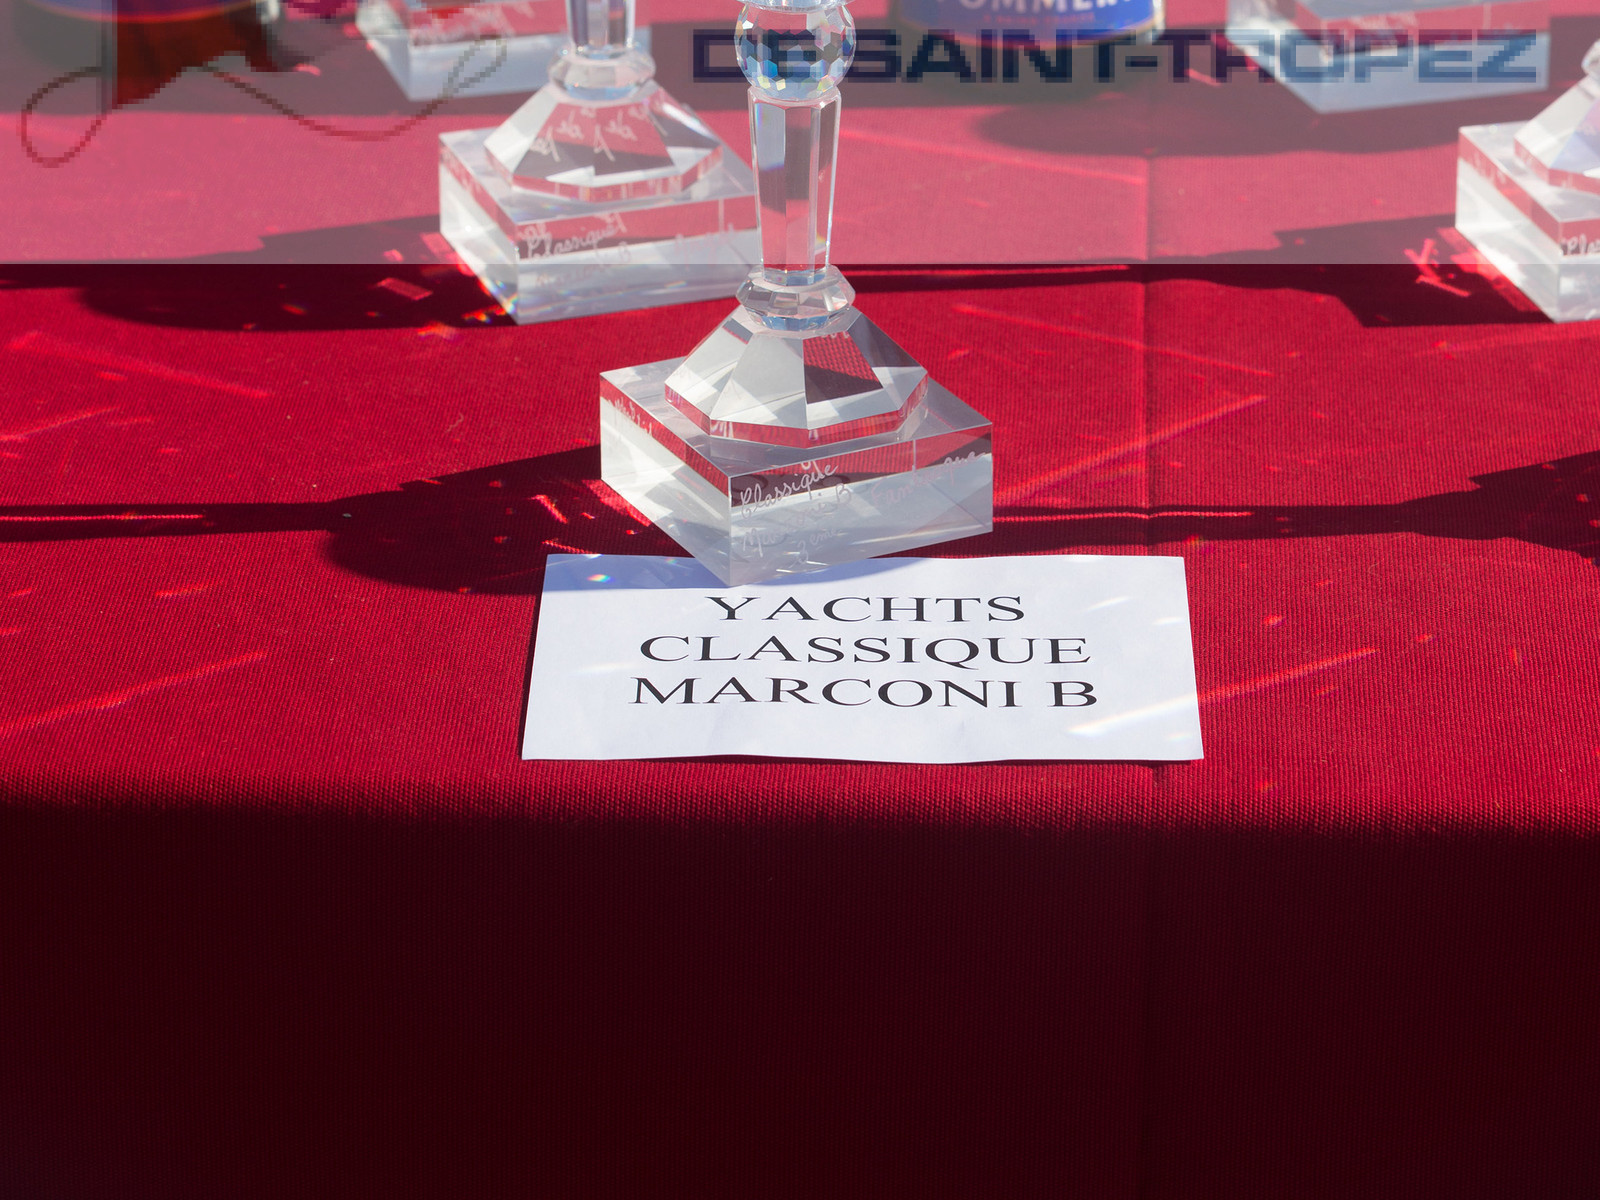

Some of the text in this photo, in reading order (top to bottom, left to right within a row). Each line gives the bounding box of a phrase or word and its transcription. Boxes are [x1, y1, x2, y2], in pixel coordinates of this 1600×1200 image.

[740, 461, 839, 519] Classique
[704, 596, 1025, 622] YACHTS
[640, 635, 1091, 670] CLASSIQUE
[629, 677, 1097, 708] MARCONI B
